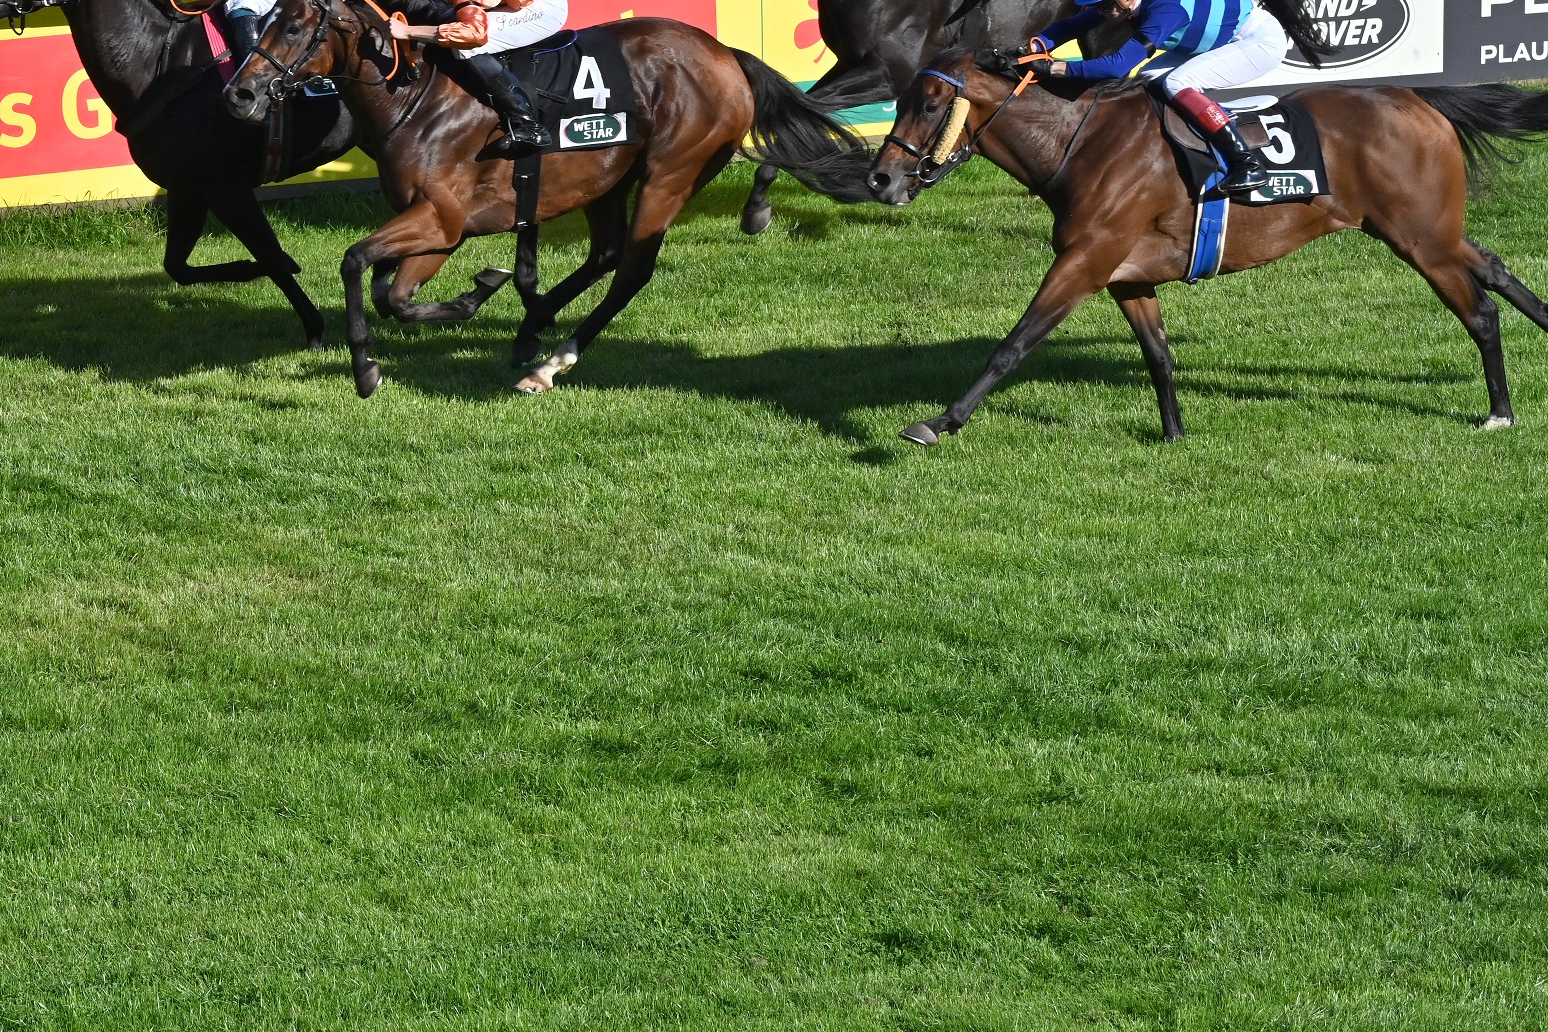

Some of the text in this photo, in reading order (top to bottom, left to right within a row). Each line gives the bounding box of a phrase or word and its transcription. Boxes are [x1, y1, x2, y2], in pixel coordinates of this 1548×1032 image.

[573, 56, 611, 109] 4
[573, 119, 606, 132] WETT
[583, 128, 613, 140] STAR
[1258, 114, 1295, 165] 5
[1272, 186, 1305, 196] STAR
